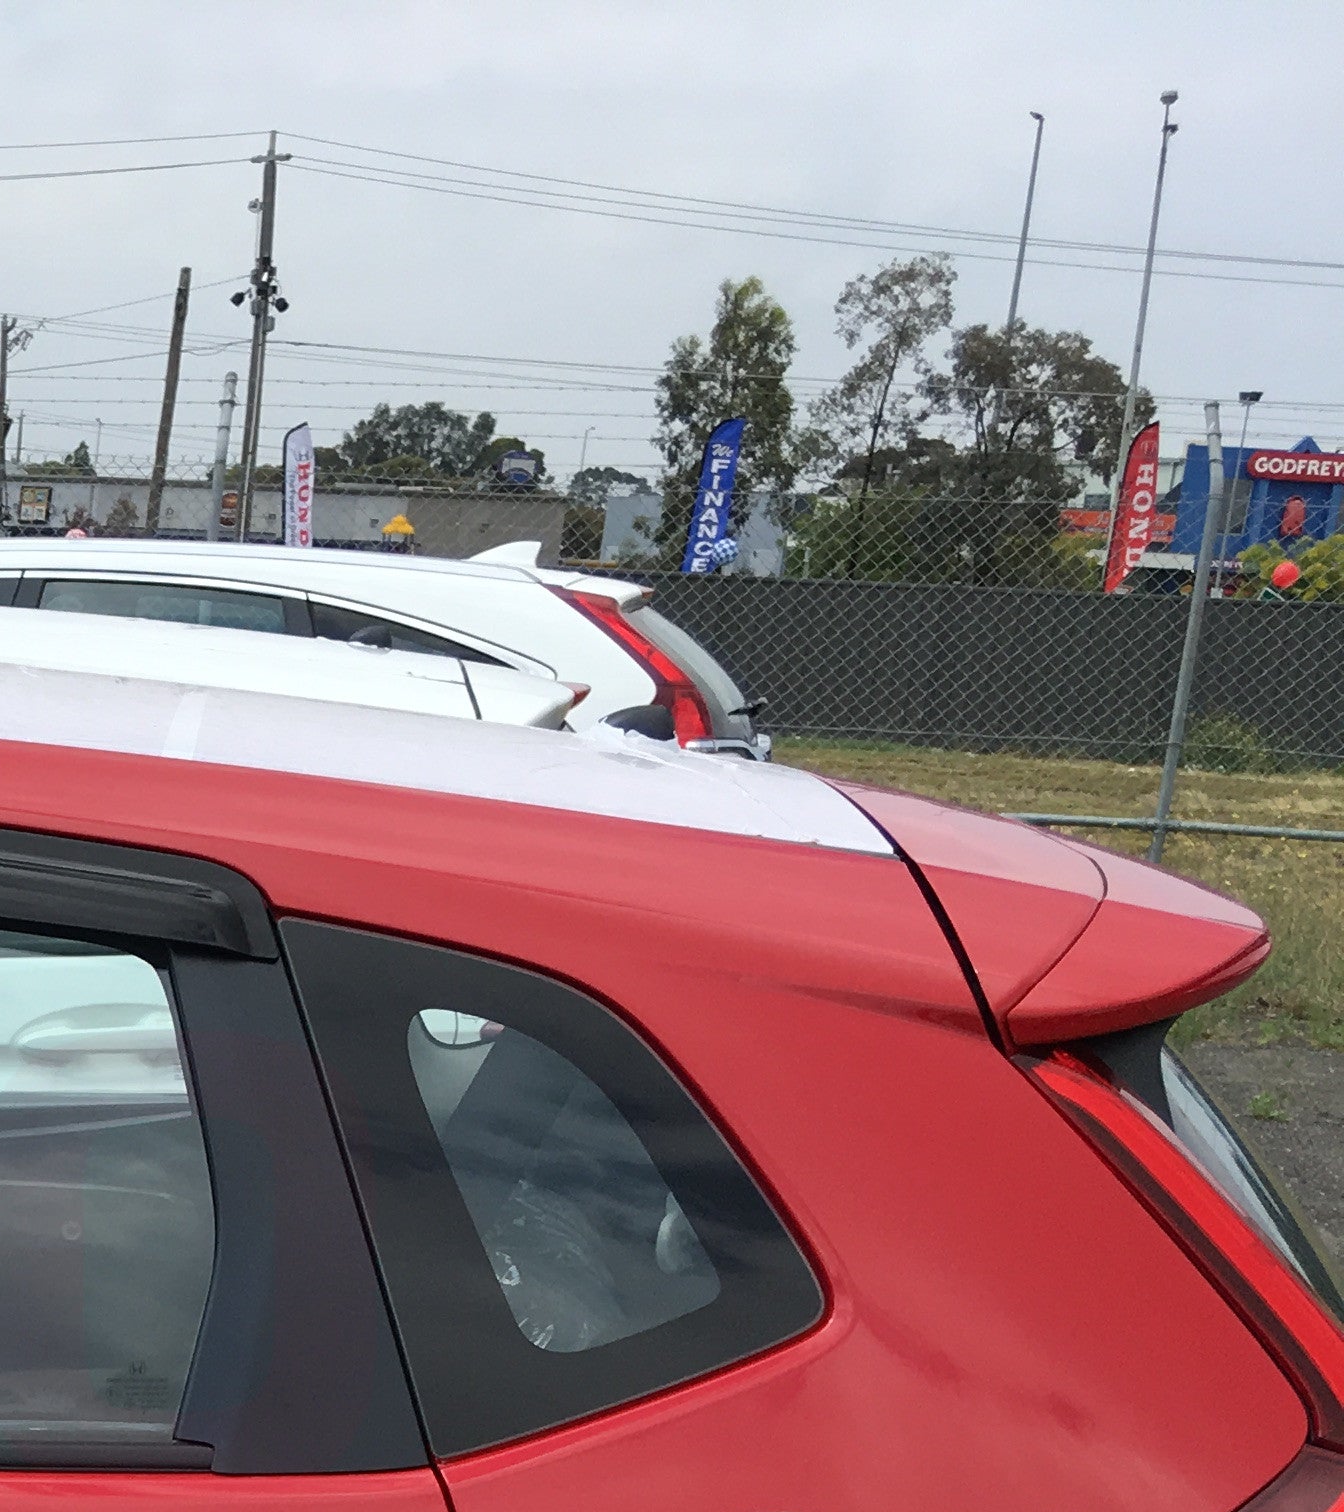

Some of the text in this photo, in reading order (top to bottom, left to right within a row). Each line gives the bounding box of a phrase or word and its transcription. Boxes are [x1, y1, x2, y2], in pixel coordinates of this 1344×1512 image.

[690, 458, 731, 573] FINANCE
[1122, 463, 1154, 577] HOND
[1254, 456, 1344, 478] GODFREY
